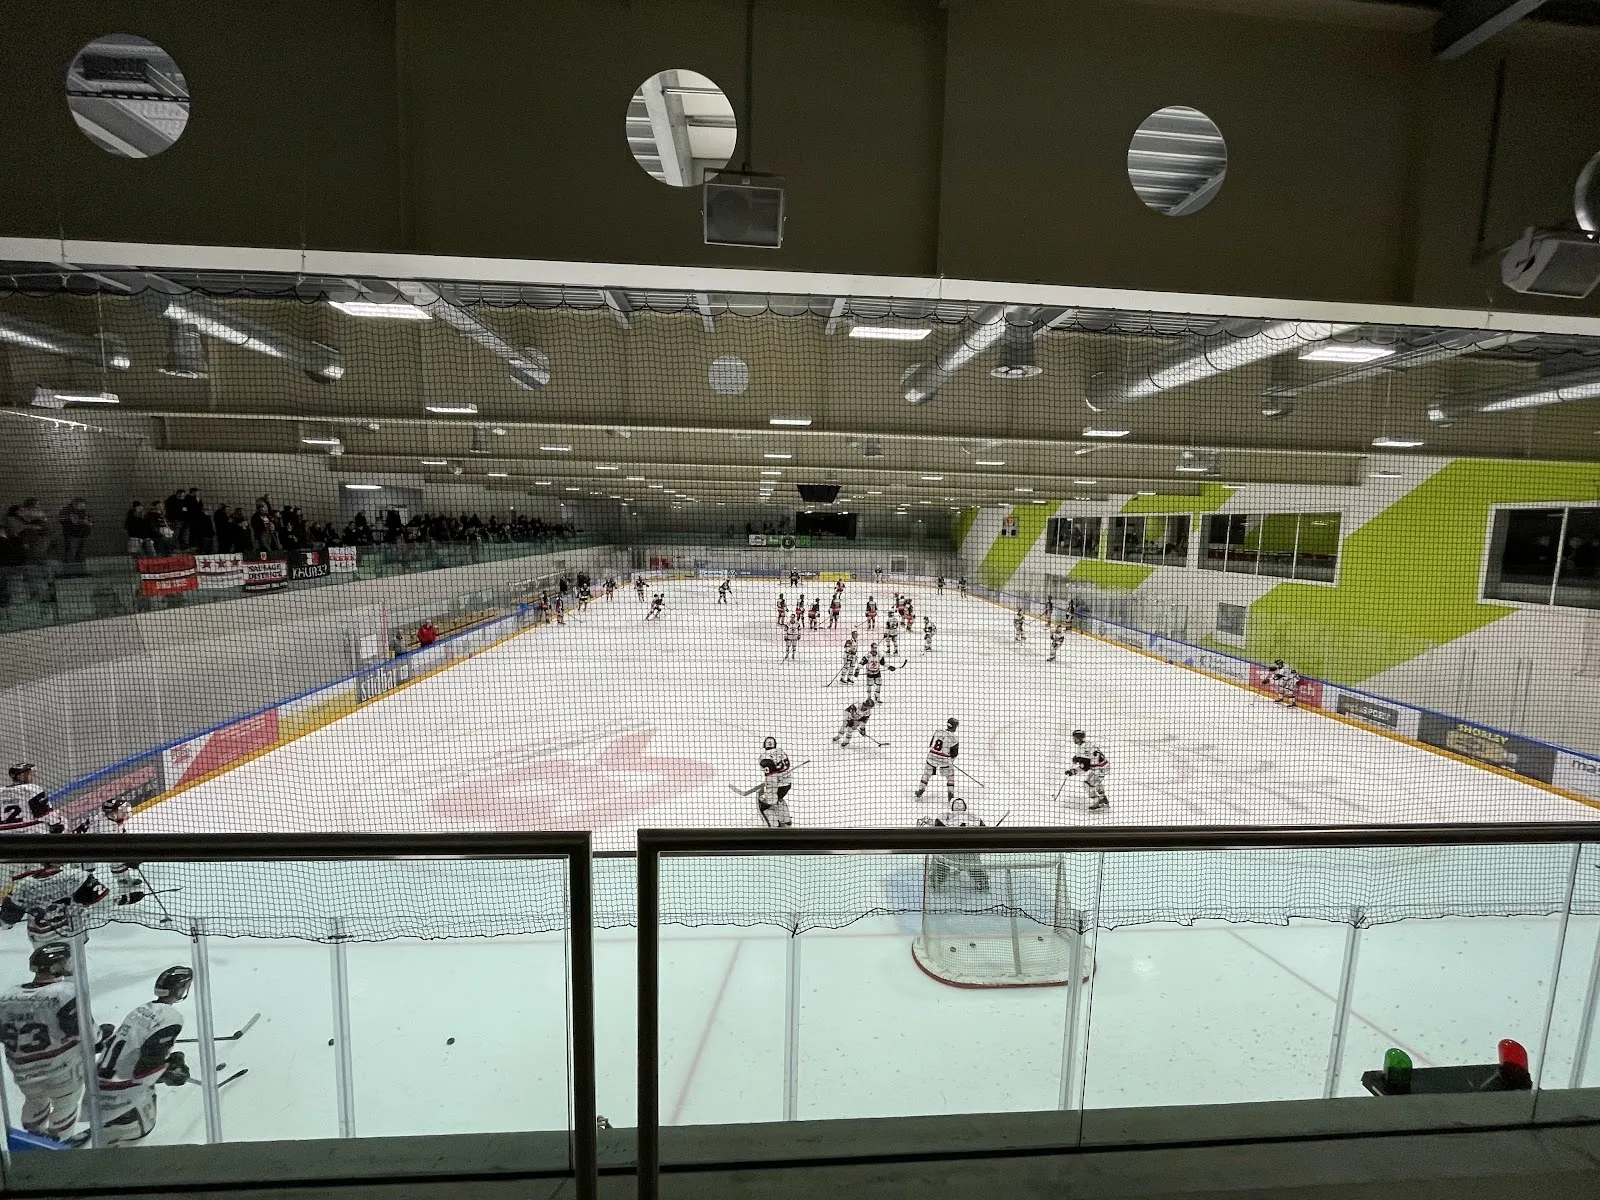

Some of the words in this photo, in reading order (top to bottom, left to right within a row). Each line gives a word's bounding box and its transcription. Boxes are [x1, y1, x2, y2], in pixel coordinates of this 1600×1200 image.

[1458, 724, 1508, 744] SHORLEY
[1572, 759, 1600, 777] ma
[0, 804, 23, 823] 2
